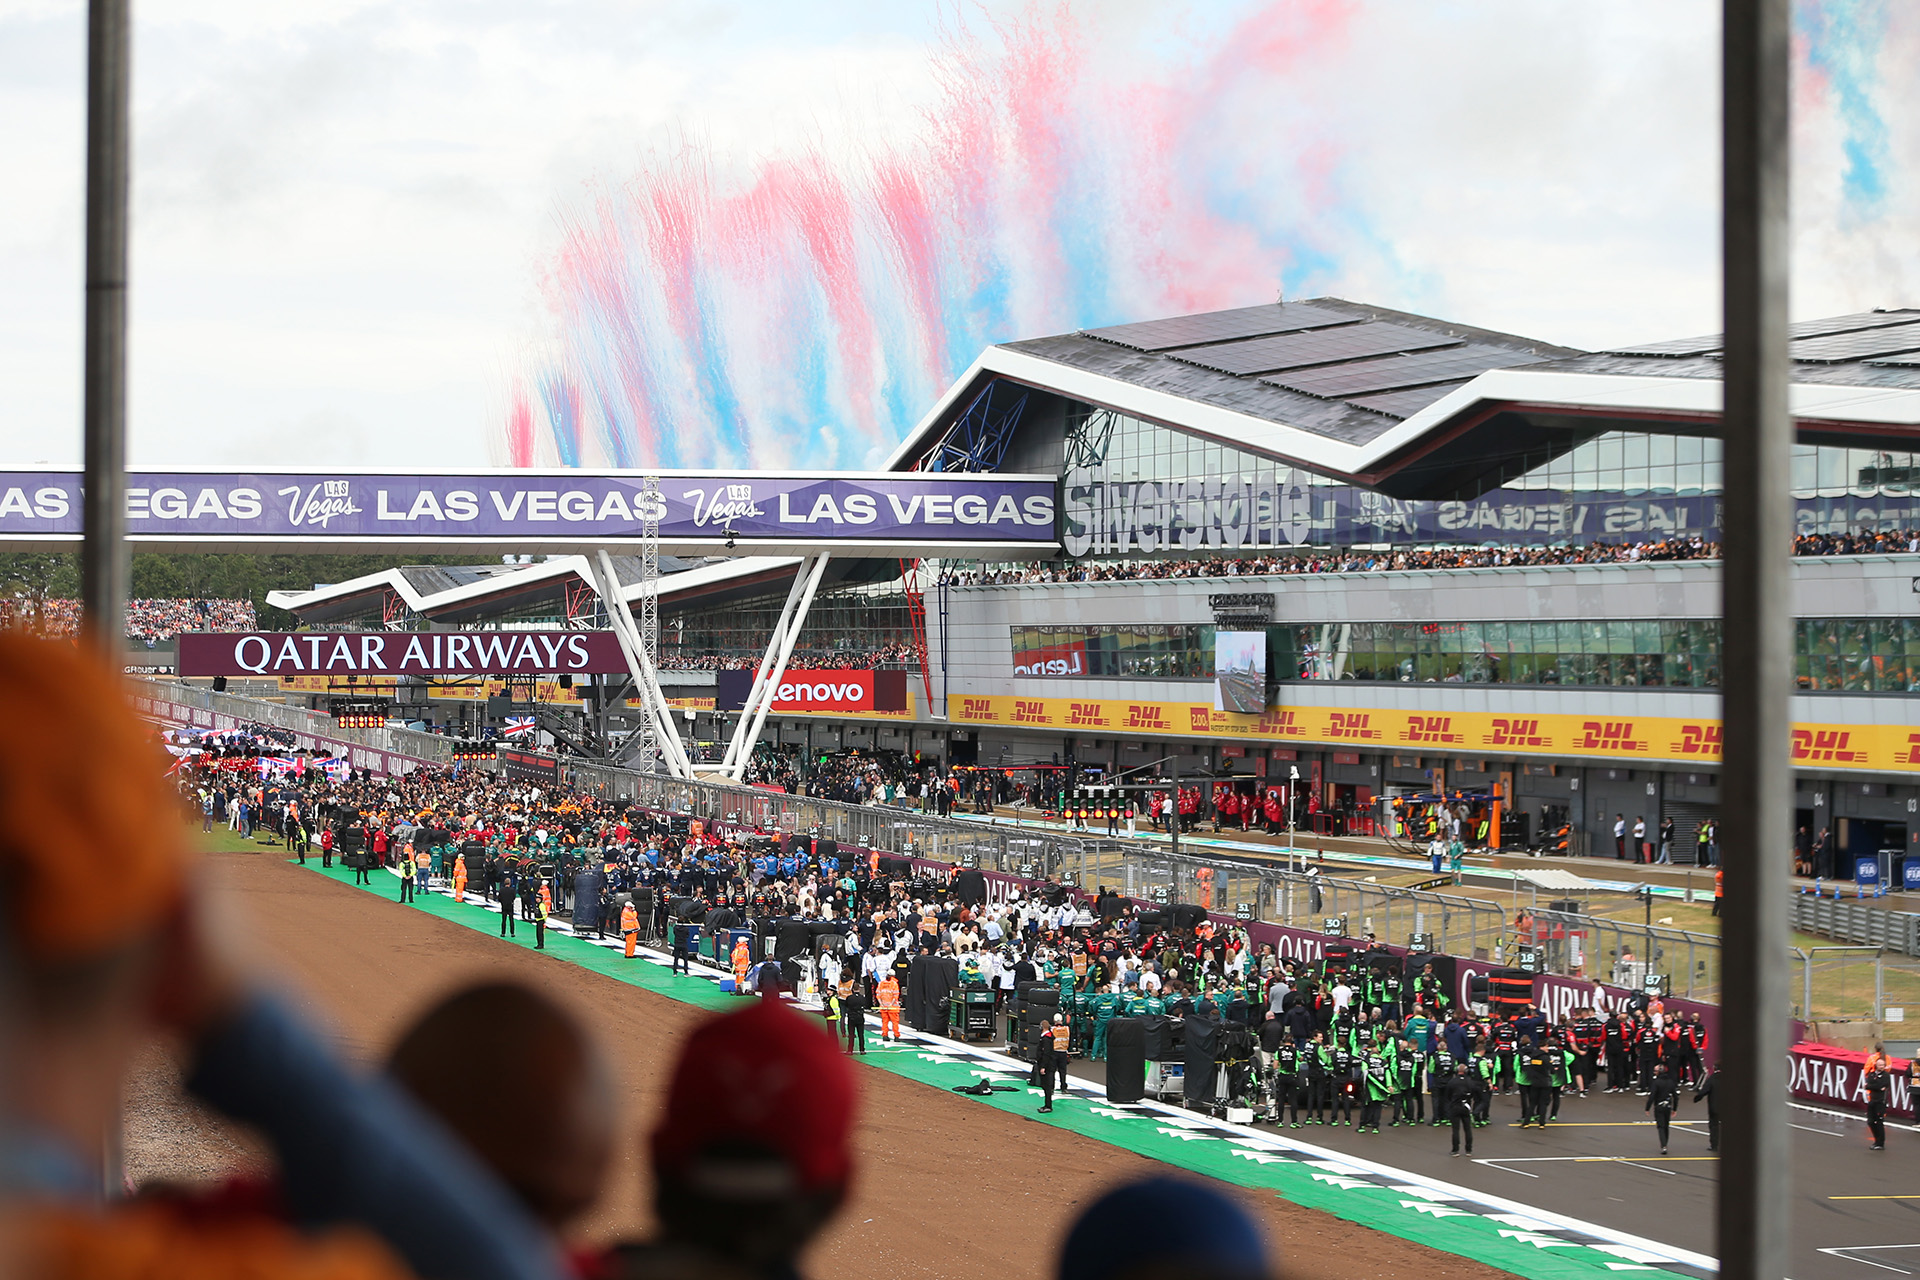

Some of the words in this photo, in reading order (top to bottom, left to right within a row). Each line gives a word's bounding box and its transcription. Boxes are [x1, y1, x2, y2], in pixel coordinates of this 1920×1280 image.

[326, 482, 348, 496] LAS
[729, 486, 750, 499] LAS
[81, 487, 263, 520] EGAS
[278, 484, 363, 529] Vegas
[377, 489, 480, 521] LAS
[489, 490, 669, 522] VEGAS
[683, 485, 765, 529] Vegas
[779, 493, 878, 525] LAS
[886, 493, 1055, 526] VEGAS
[1063, 466, 1312, 557] Silverstone
[234, 634, 388, 674] QATAR
[400, 633, 590, 670] AIRWAYS
[962, 699, 992, 720] DHL
[1014, 701, 1047, 723] DHL
[1069, 703, 1104, 726] DHL
[1128, 705, 1164, 729] DHL
[1257, 711, 1298, 735] DHL
[1329, 713, 1373, 738] DHL
[1407, 716, 1455, 743] DHL
[1491, 719, 1542, 746] DHL
[1582, 722, 1638, 750] DHL
[1681, 725, 1723, 754] DH
[1790, 730, 1855, 762] DHL
[1907, 799, 1918, 813] 03
[858, 834, 869, 842] 10
[903, 843, 913, 851] 55
[963, 854, 973, 862] 12
[1021, 864, 1033, 872] 22
[1858, 866, 1876, 876] FIA
[1155, 888, 1168, 897] 23
[1237, 904, 1249, 912] 31
[1325, 919, 1341, 928] 30
[1325, 928, 1341, 936] LAW
[1414, 933, 1422, 943] 5
[1278, 934, 1334, 974] QATA
[1520, 953, 1535, 963] 18
[1645, 975, 1661, 985] 87
